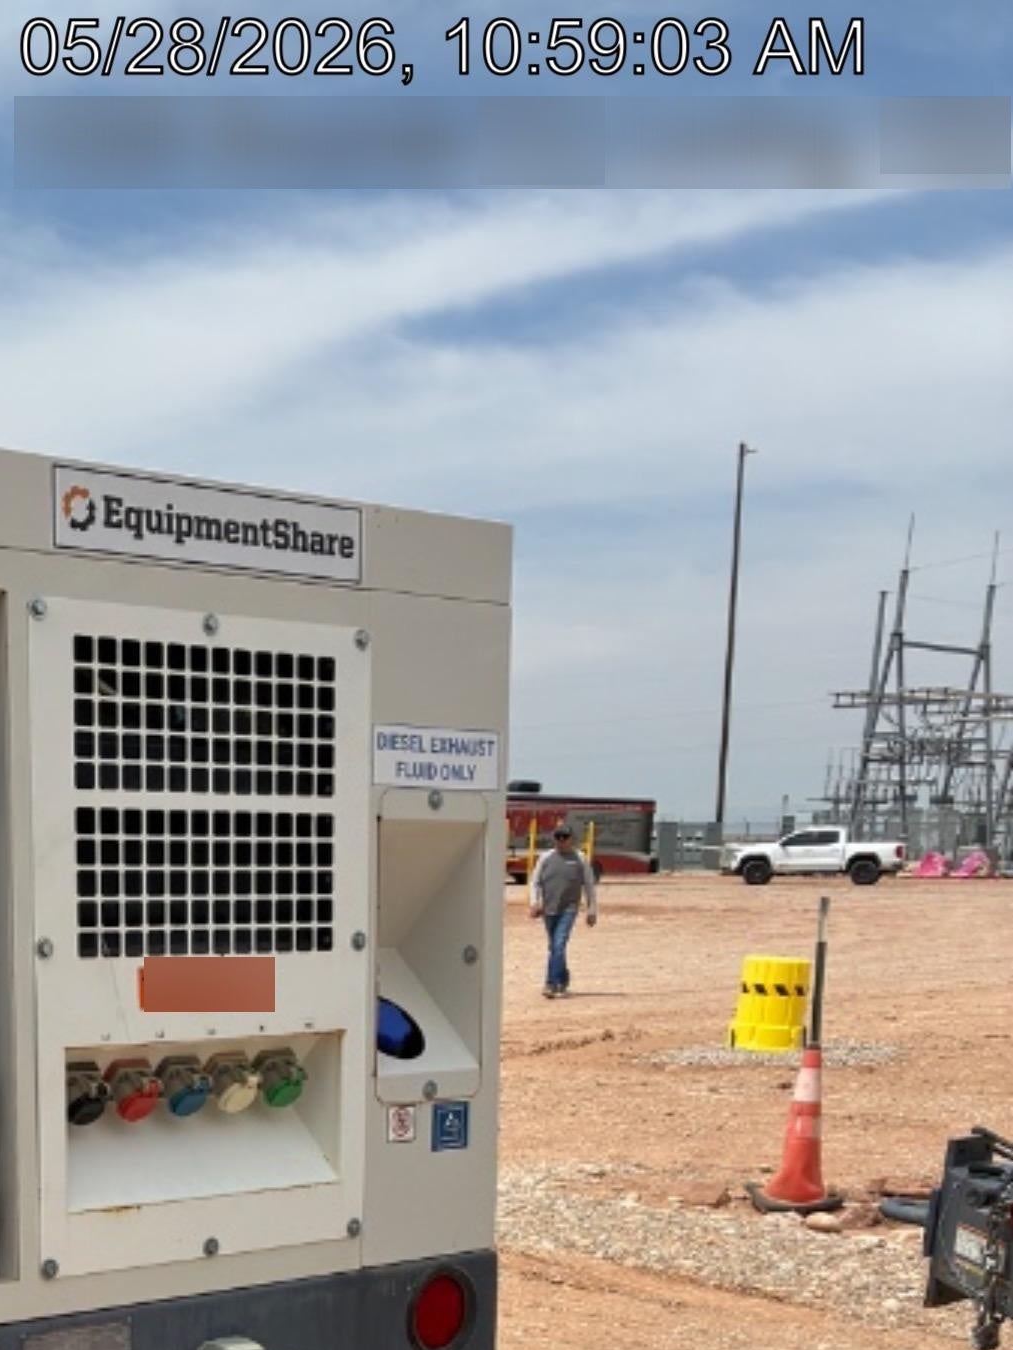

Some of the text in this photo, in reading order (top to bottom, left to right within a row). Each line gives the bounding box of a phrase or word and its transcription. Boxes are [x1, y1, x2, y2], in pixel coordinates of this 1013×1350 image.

[103, 495, 354, 558] EquipmentShare
[377, 731, 495, 756] DIESEL EXHAUST
[395, 761, 476, 780] FLUID ONLY
